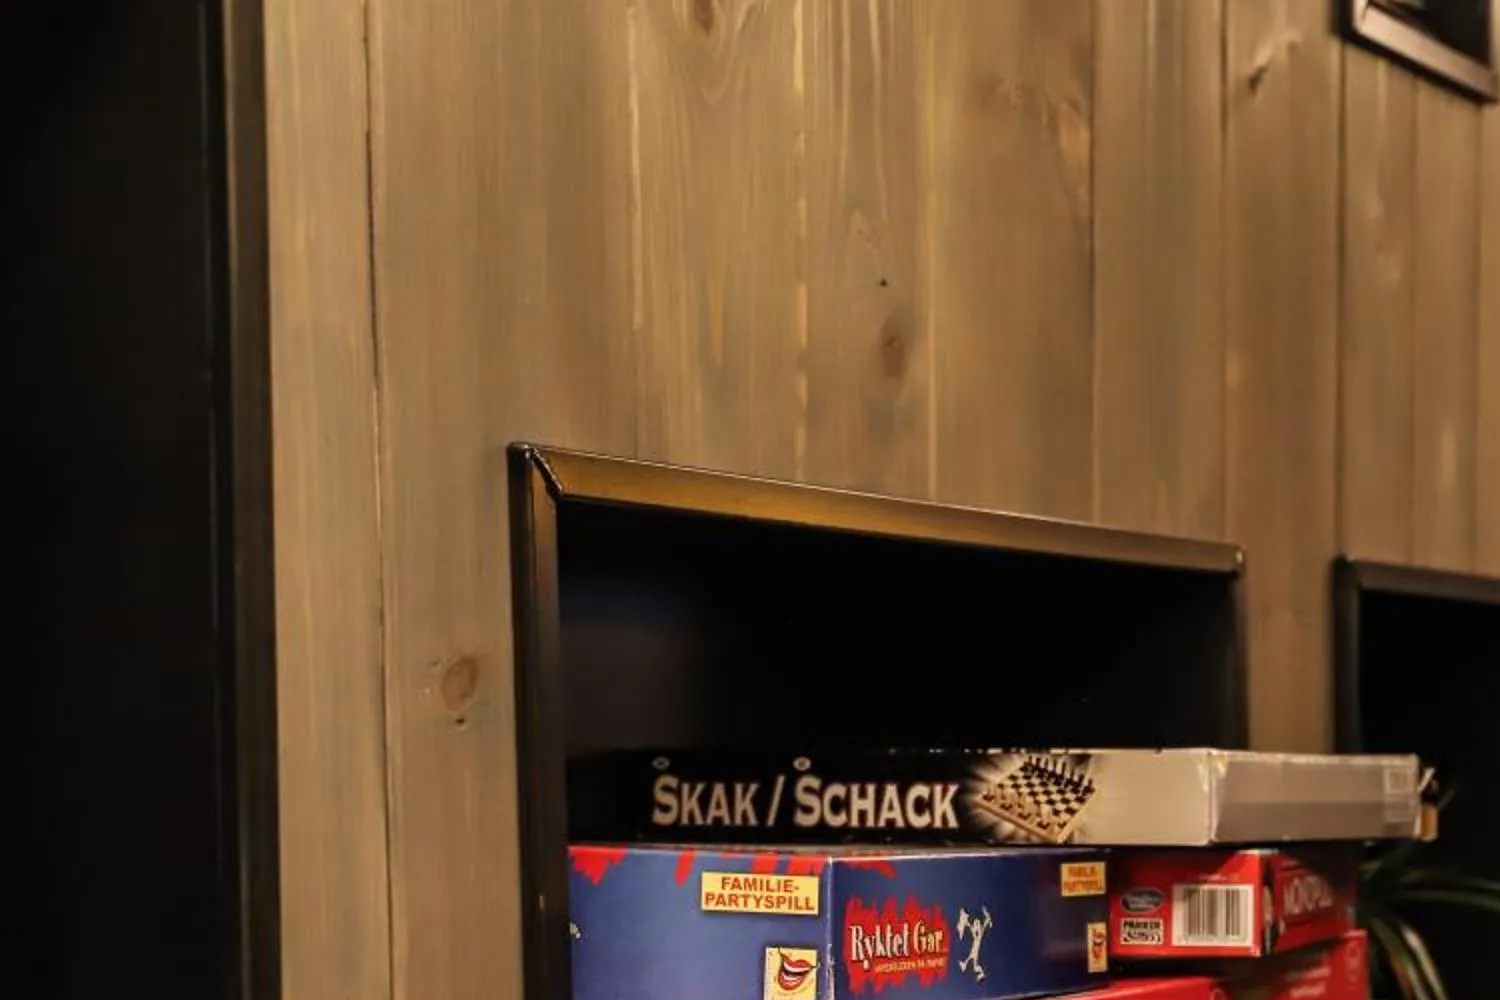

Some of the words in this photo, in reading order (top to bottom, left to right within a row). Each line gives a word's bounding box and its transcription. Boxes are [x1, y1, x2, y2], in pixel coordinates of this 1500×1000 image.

[720, 875, 800, 893] FAMILIE-
[704, 891, 815, 912] PARTYSPILL
[848, 922, 910, 971] Ryktet
